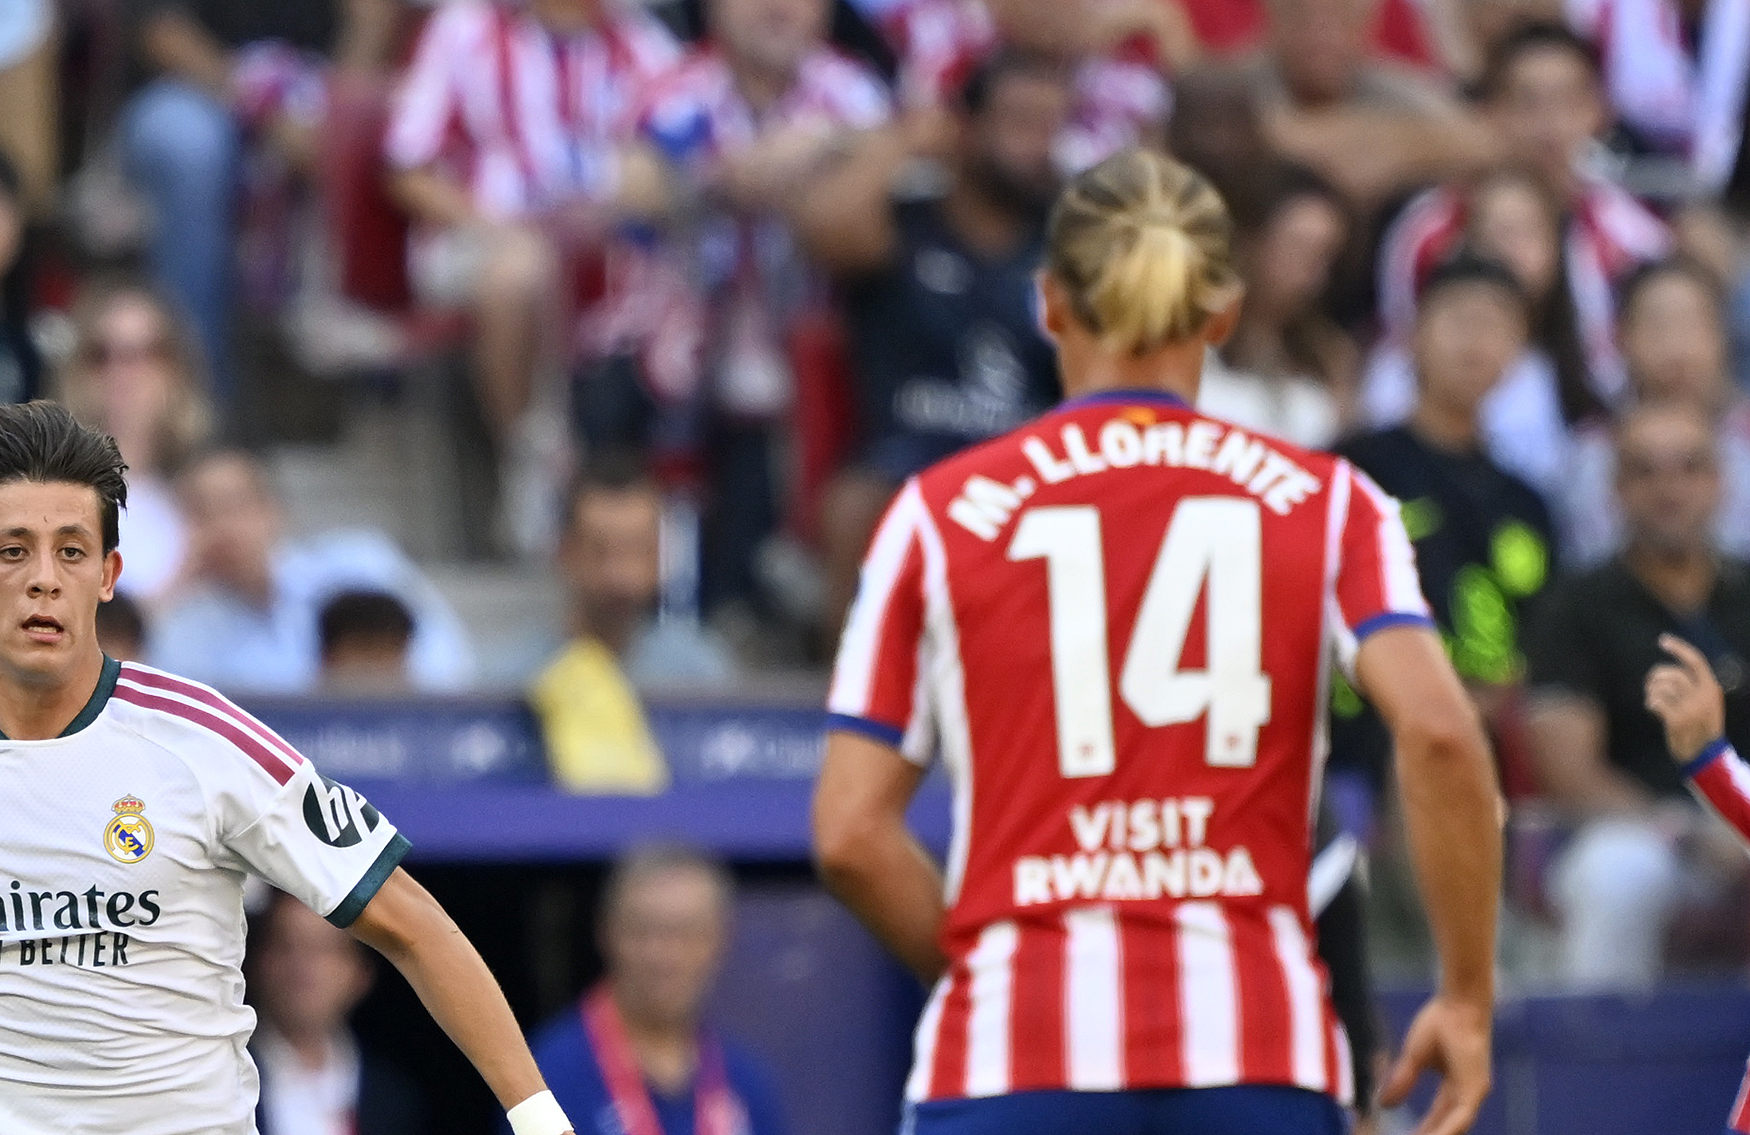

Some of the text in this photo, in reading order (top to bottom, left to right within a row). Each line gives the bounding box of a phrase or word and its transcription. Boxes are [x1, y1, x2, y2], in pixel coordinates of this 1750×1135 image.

[947, 420, 1321, 542] M. LLORENTE
[1006, 494, 1272, 779] 14
[1070, 796, 1214, 852] VISIT
[1013, 847, 1263, 907] RWANDA
